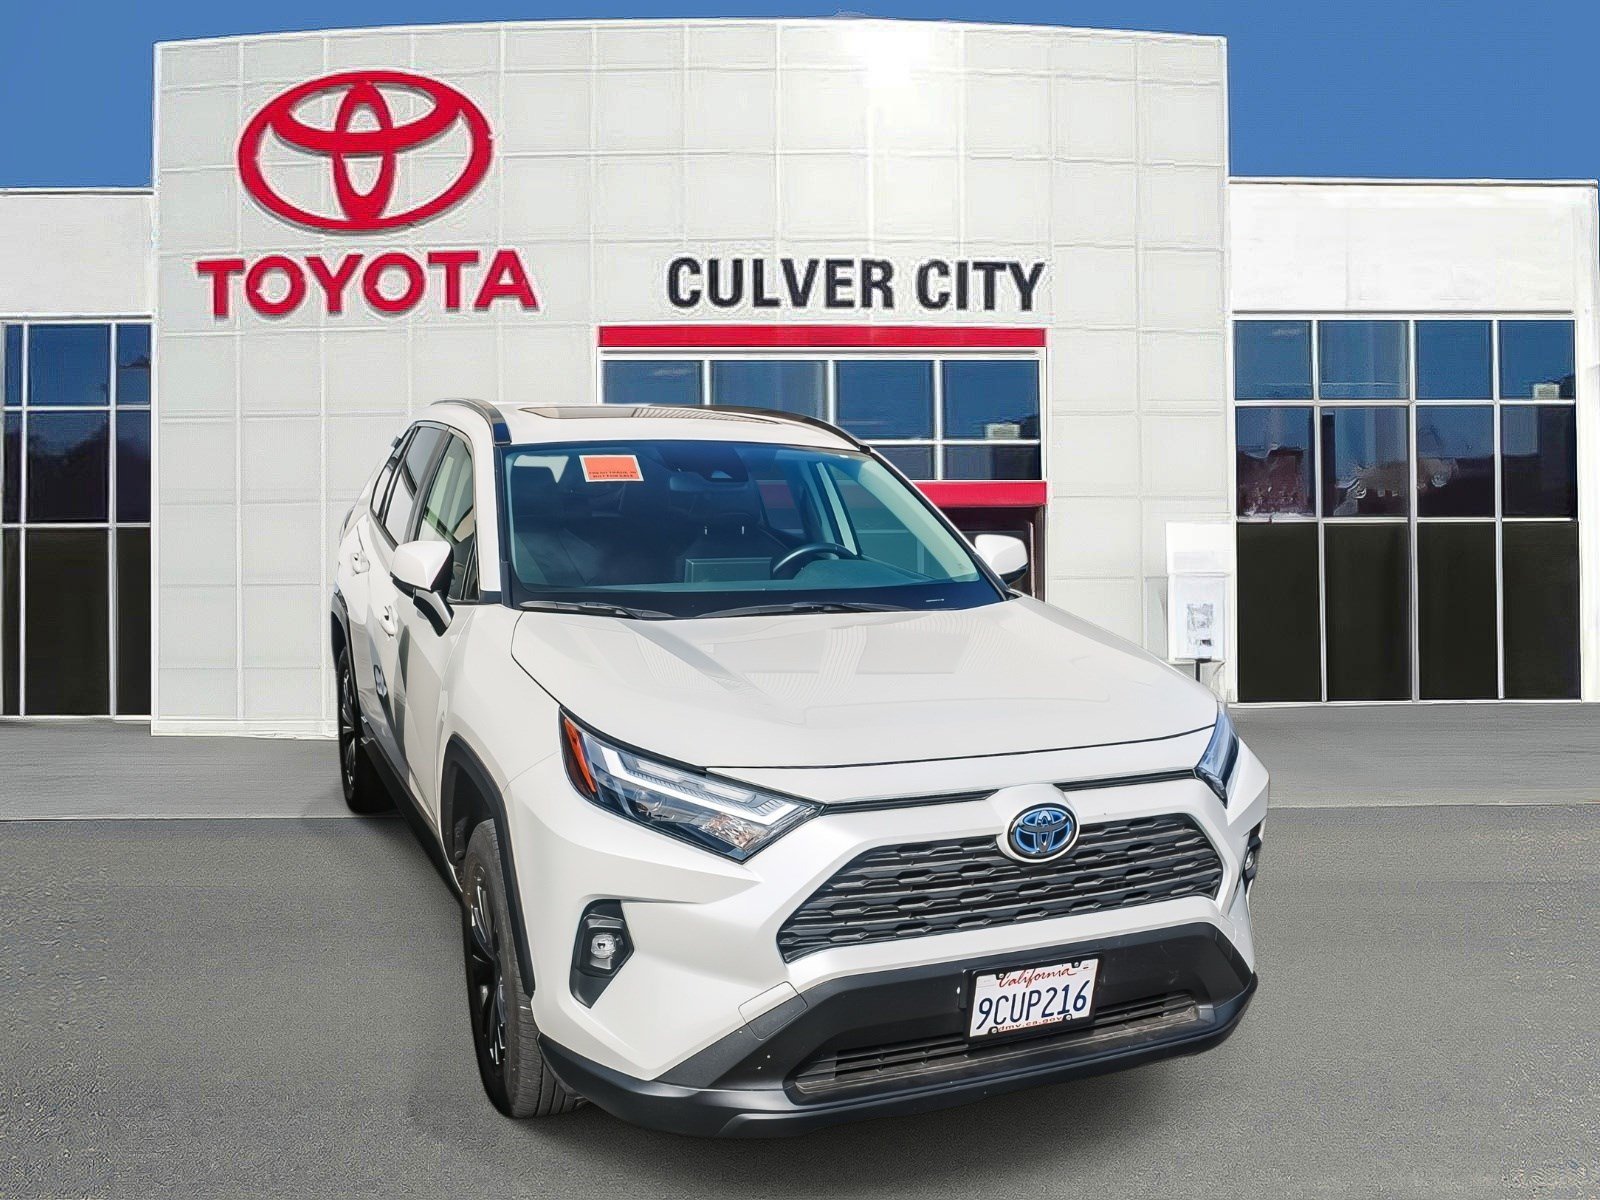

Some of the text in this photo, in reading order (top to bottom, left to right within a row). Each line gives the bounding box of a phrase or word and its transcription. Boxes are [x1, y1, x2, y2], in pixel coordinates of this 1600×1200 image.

[195, 249, 539, 319] TOYOTA
[668, 256, 1046, 311] CULVER CITY
[998, 965, 1076, 988] California
[976, 980, 1090, 1030] 9CUP216
[998, 1016, 1063, 1032] dmv.ca.gov
